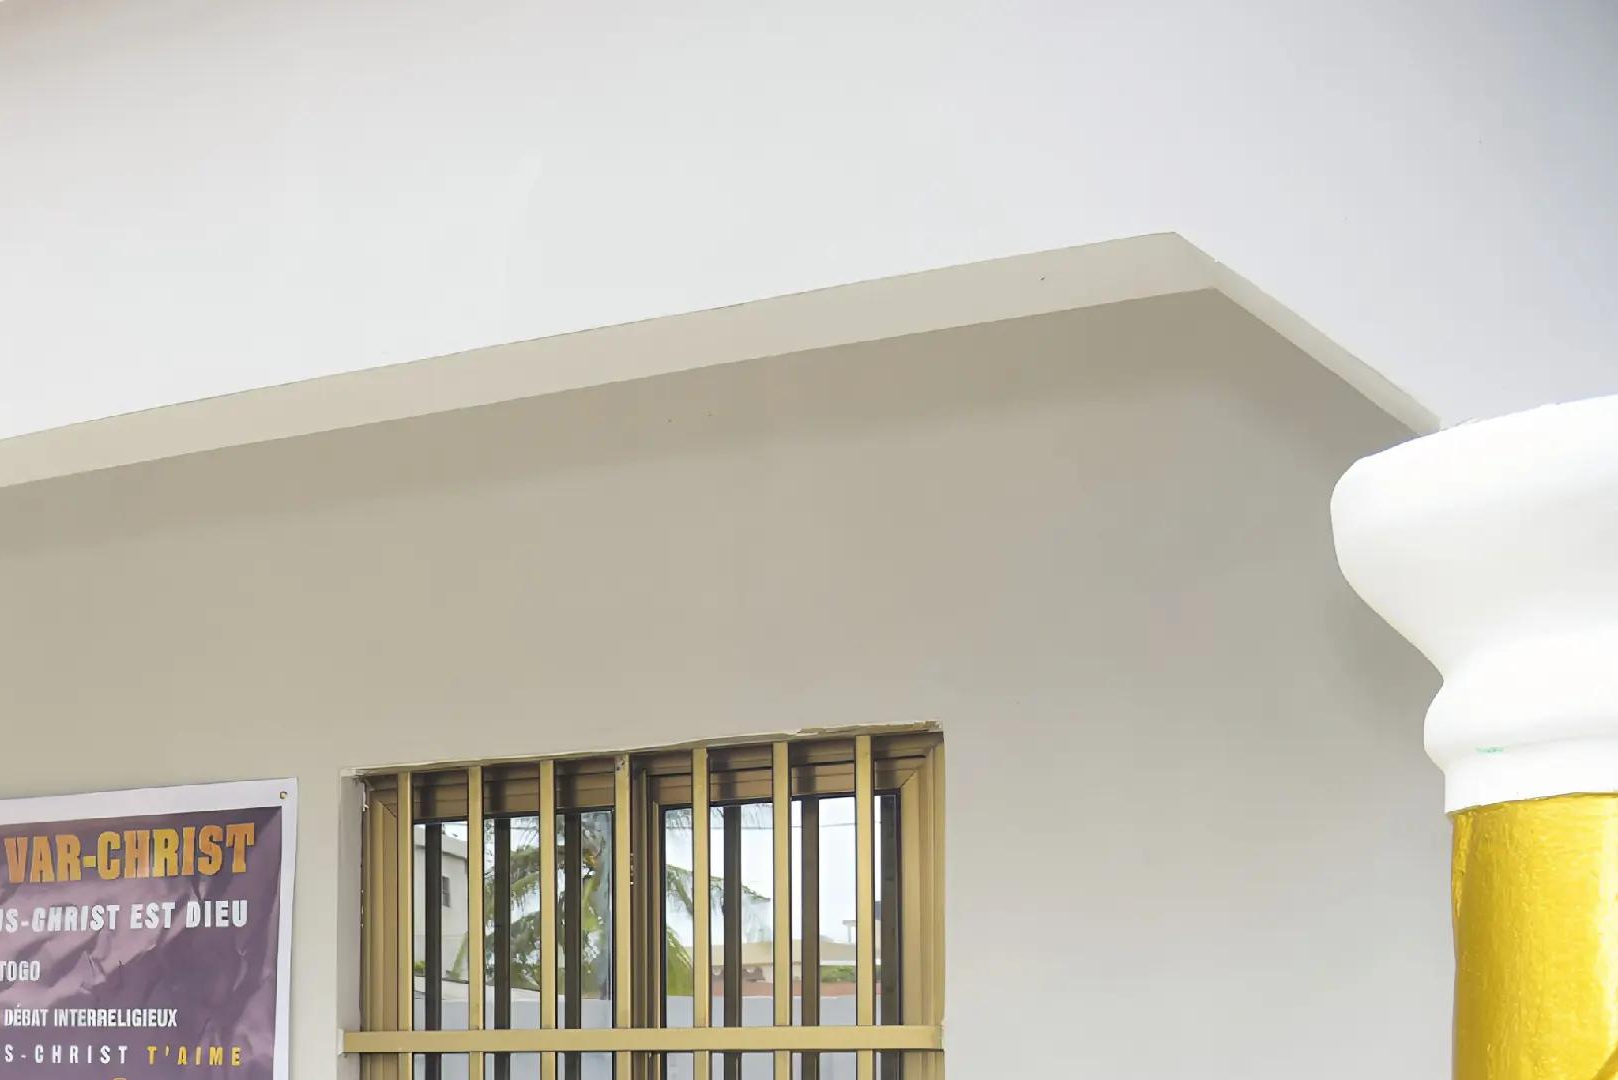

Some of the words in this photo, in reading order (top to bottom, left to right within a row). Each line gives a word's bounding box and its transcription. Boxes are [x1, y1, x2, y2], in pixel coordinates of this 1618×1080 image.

[4, 822, 255, 884] VAR-CHRIST
[131, 902, 176, 929] EST
[186, 900, 248, 929] DIEU
[4, 1004, 48, 1027] DÉBAT
[54, 1009, 178, 1028] INTERRELIGIEUX
[147, 1044, 242, 1067] T'AIME
